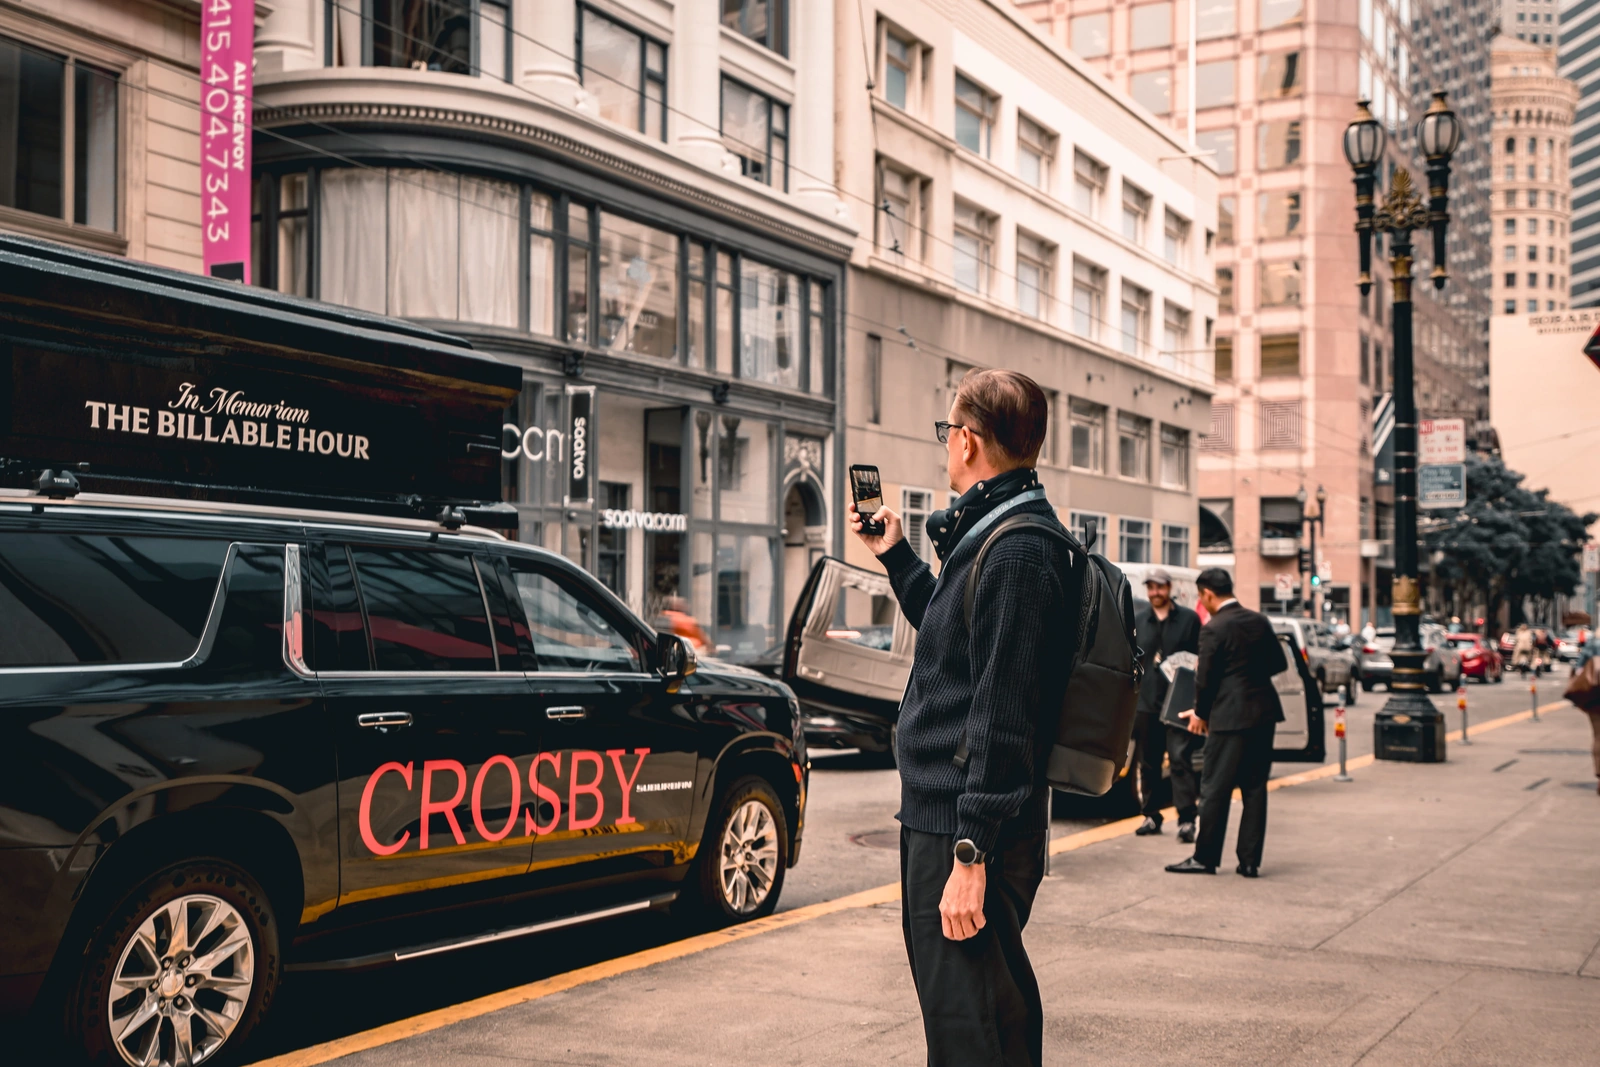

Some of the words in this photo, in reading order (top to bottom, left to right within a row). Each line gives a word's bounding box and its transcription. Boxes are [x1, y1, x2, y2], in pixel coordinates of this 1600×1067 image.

[233, 61, 247, 91] ALI
[206, 0, 232, 243] 415.404.7343
[85, 400, 150, 434] THE
[157, 410, 291, 449] BILLABLE
[297, 427, 370, 460] HOUR
[167, 381, 200, 411] In
[199, 387, 311, 424] Memoriam
[573, 416, 587, 480] saatva
[604, 508, 688, 532] saatva.com
[358, 748, 651, 856] CROSBY
